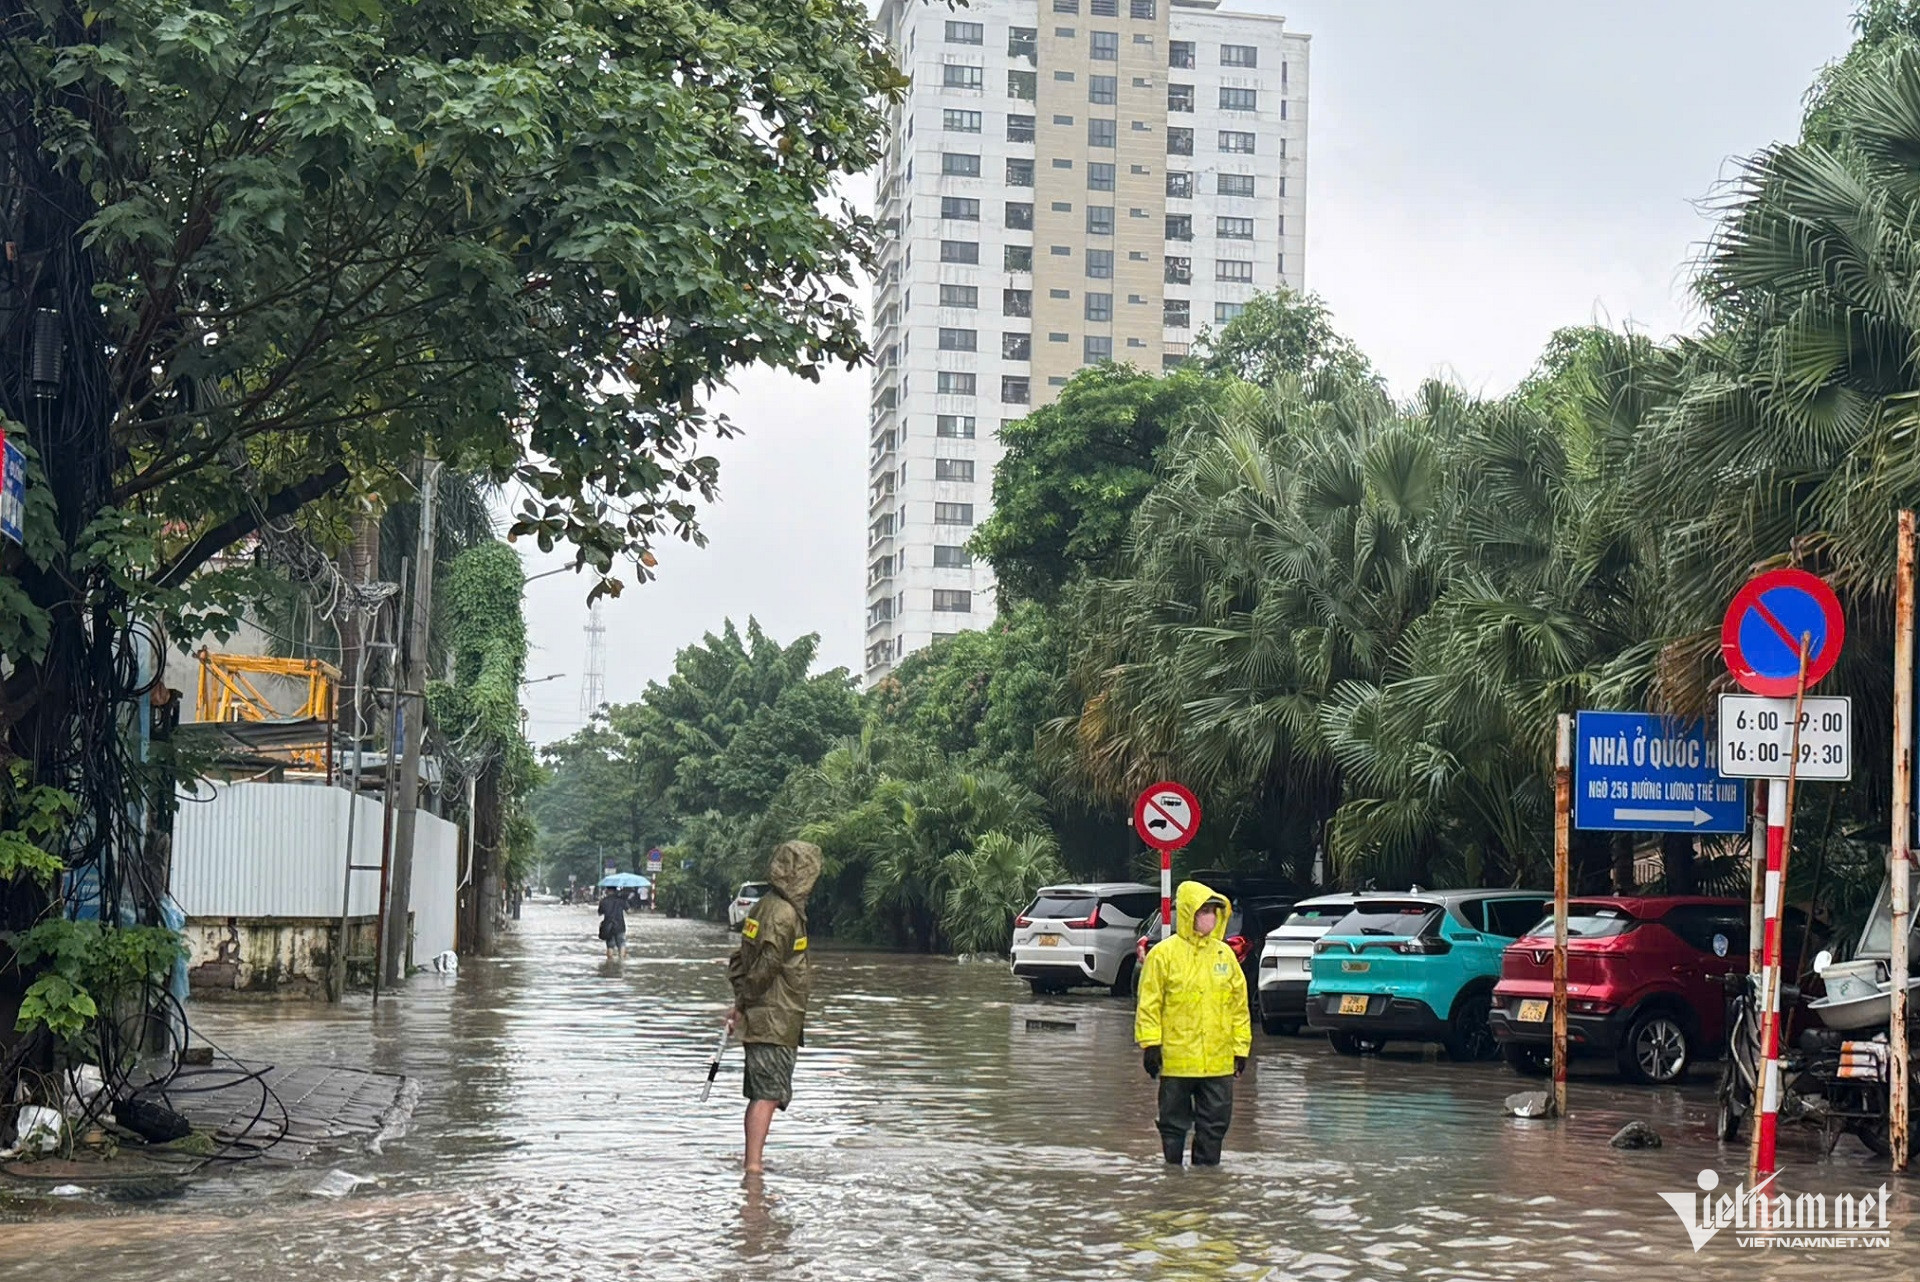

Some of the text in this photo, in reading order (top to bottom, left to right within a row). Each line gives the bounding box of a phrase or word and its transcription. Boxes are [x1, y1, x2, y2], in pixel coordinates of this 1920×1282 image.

[1737, 710, 1778, 731] 6:00
[1801, 712, 1842, 732] 9:00
[1589, 730, 1629, 766] NHÀ
[1633, 726, 1647, 767] Ở
[1649, 731, 1699, 770] QUỐC
[1728, 741, 1778, 762] 16:00
[1588, 777, 1737, 802] NGÕ 256 ĐƯỜNG LƯƠNG THẾ VINH
